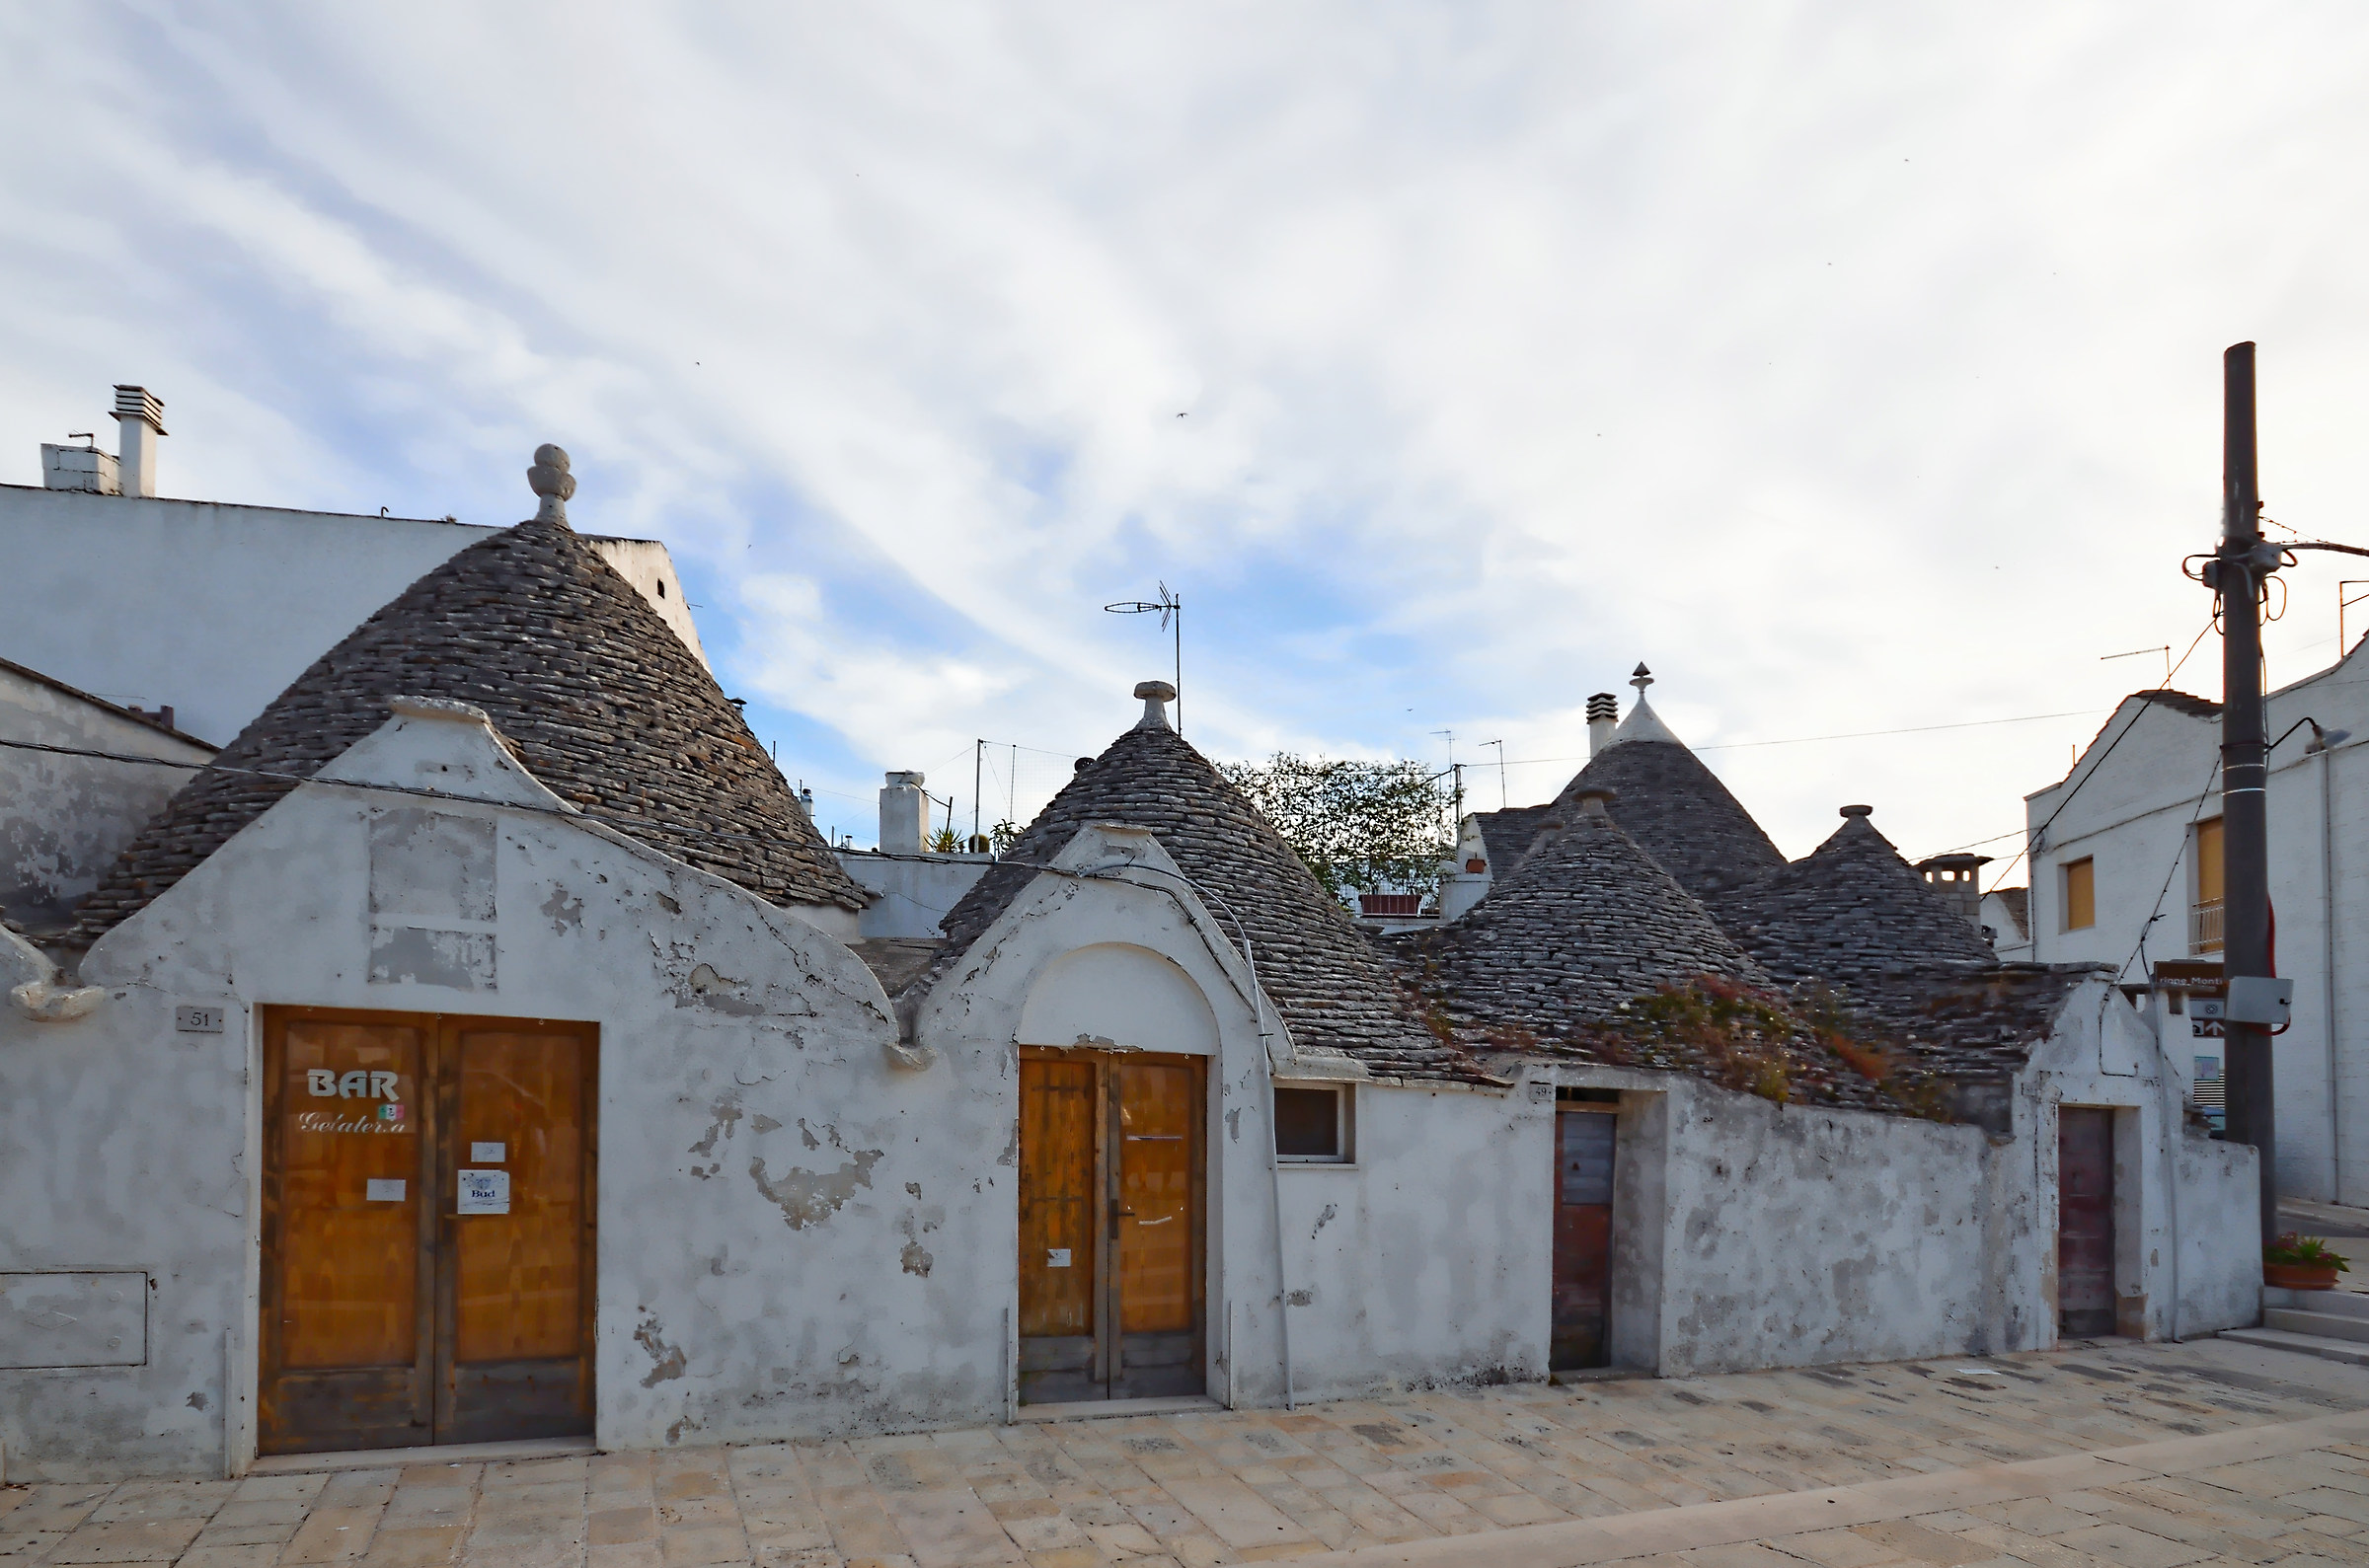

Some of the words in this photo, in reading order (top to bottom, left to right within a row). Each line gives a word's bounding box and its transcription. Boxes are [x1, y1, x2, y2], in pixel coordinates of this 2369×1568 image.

[191, 1011, 208, 1026] 51
[307, 1069, 400, 1102] BAR
[299, 1111, 405, 1134] Gelatera
[471, 1189, 496, 1198] Bud
